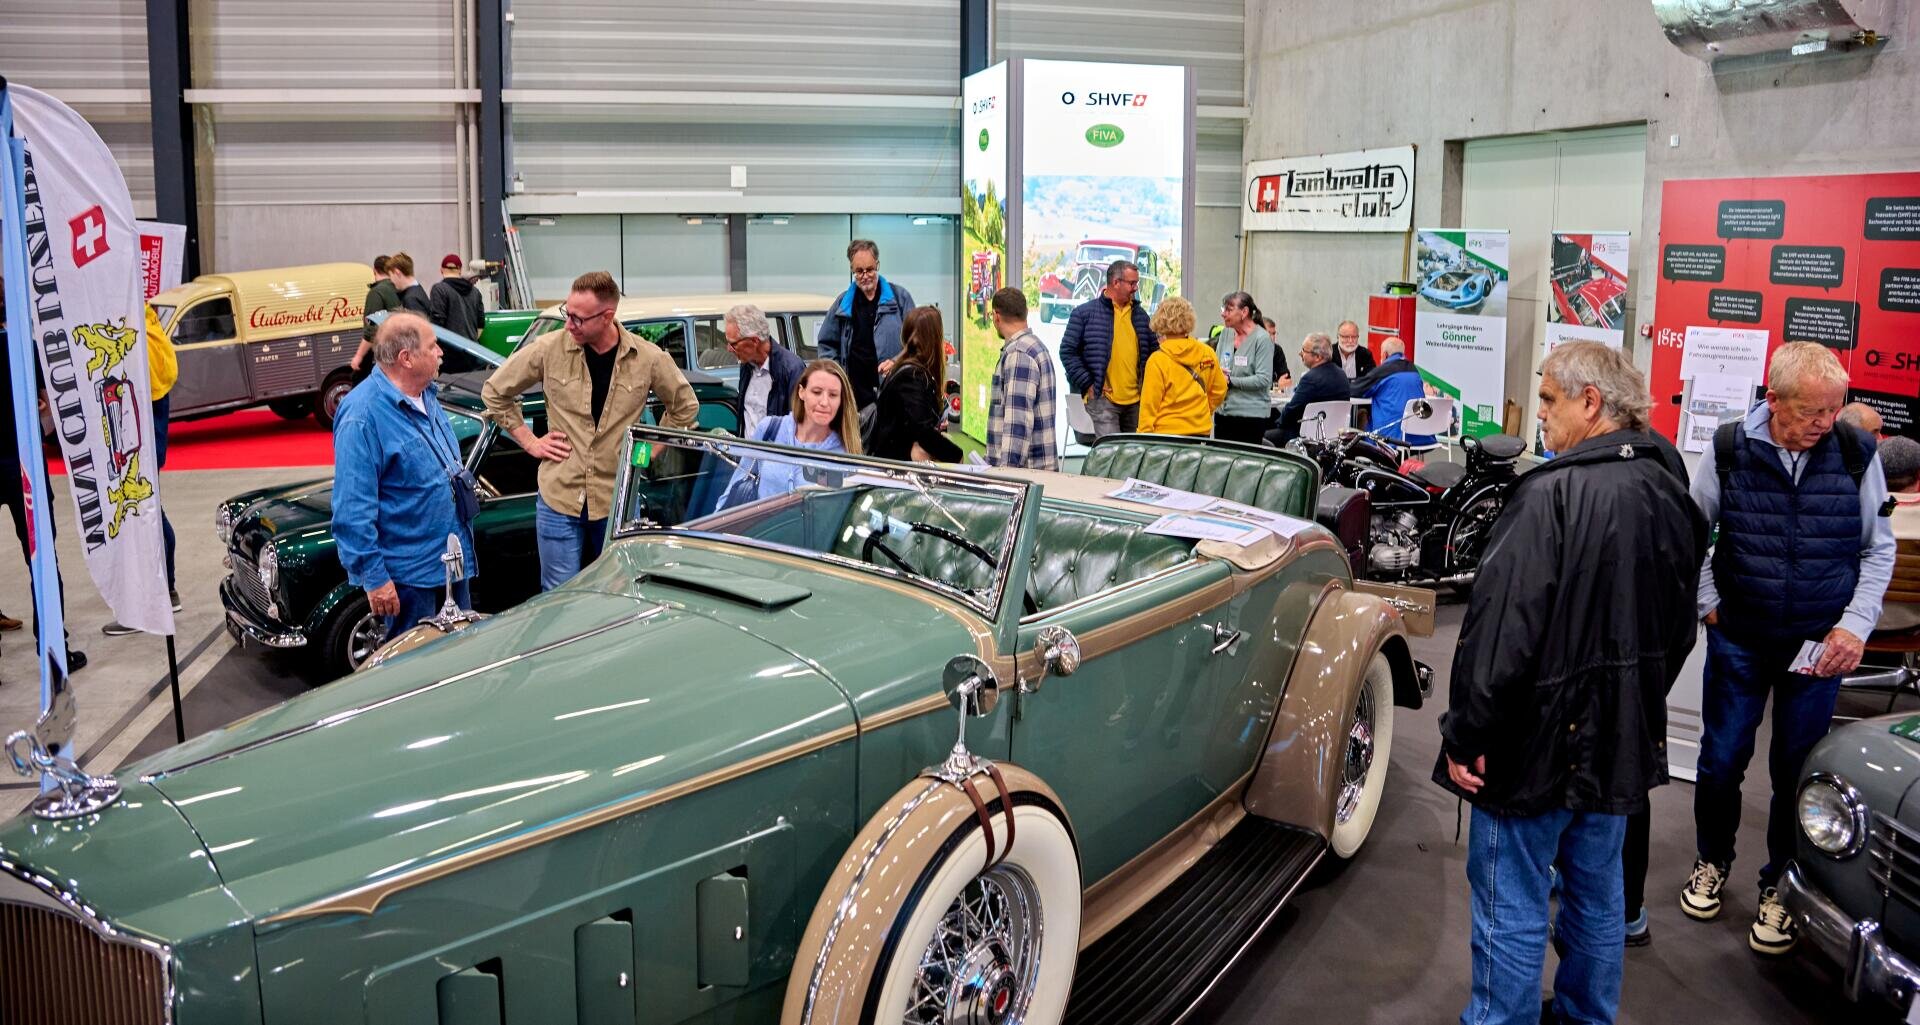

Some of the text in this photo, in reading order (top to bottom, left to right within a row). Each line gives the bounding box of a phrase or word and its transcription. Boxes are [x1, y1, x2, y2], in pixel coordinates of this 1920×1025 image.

[1086, 92, 1133, 106] SHVF
[1093, 130, 1117, 141] FIVA
[1285, 164, 1394, 198] Lambretta
[1341, 193, 1391, 218] club
[149, 240, 160, 297] AUTOMOBILE
[1442, 331, 1476, 342] Gönner
[1719, 364, 1724, 373] ?
